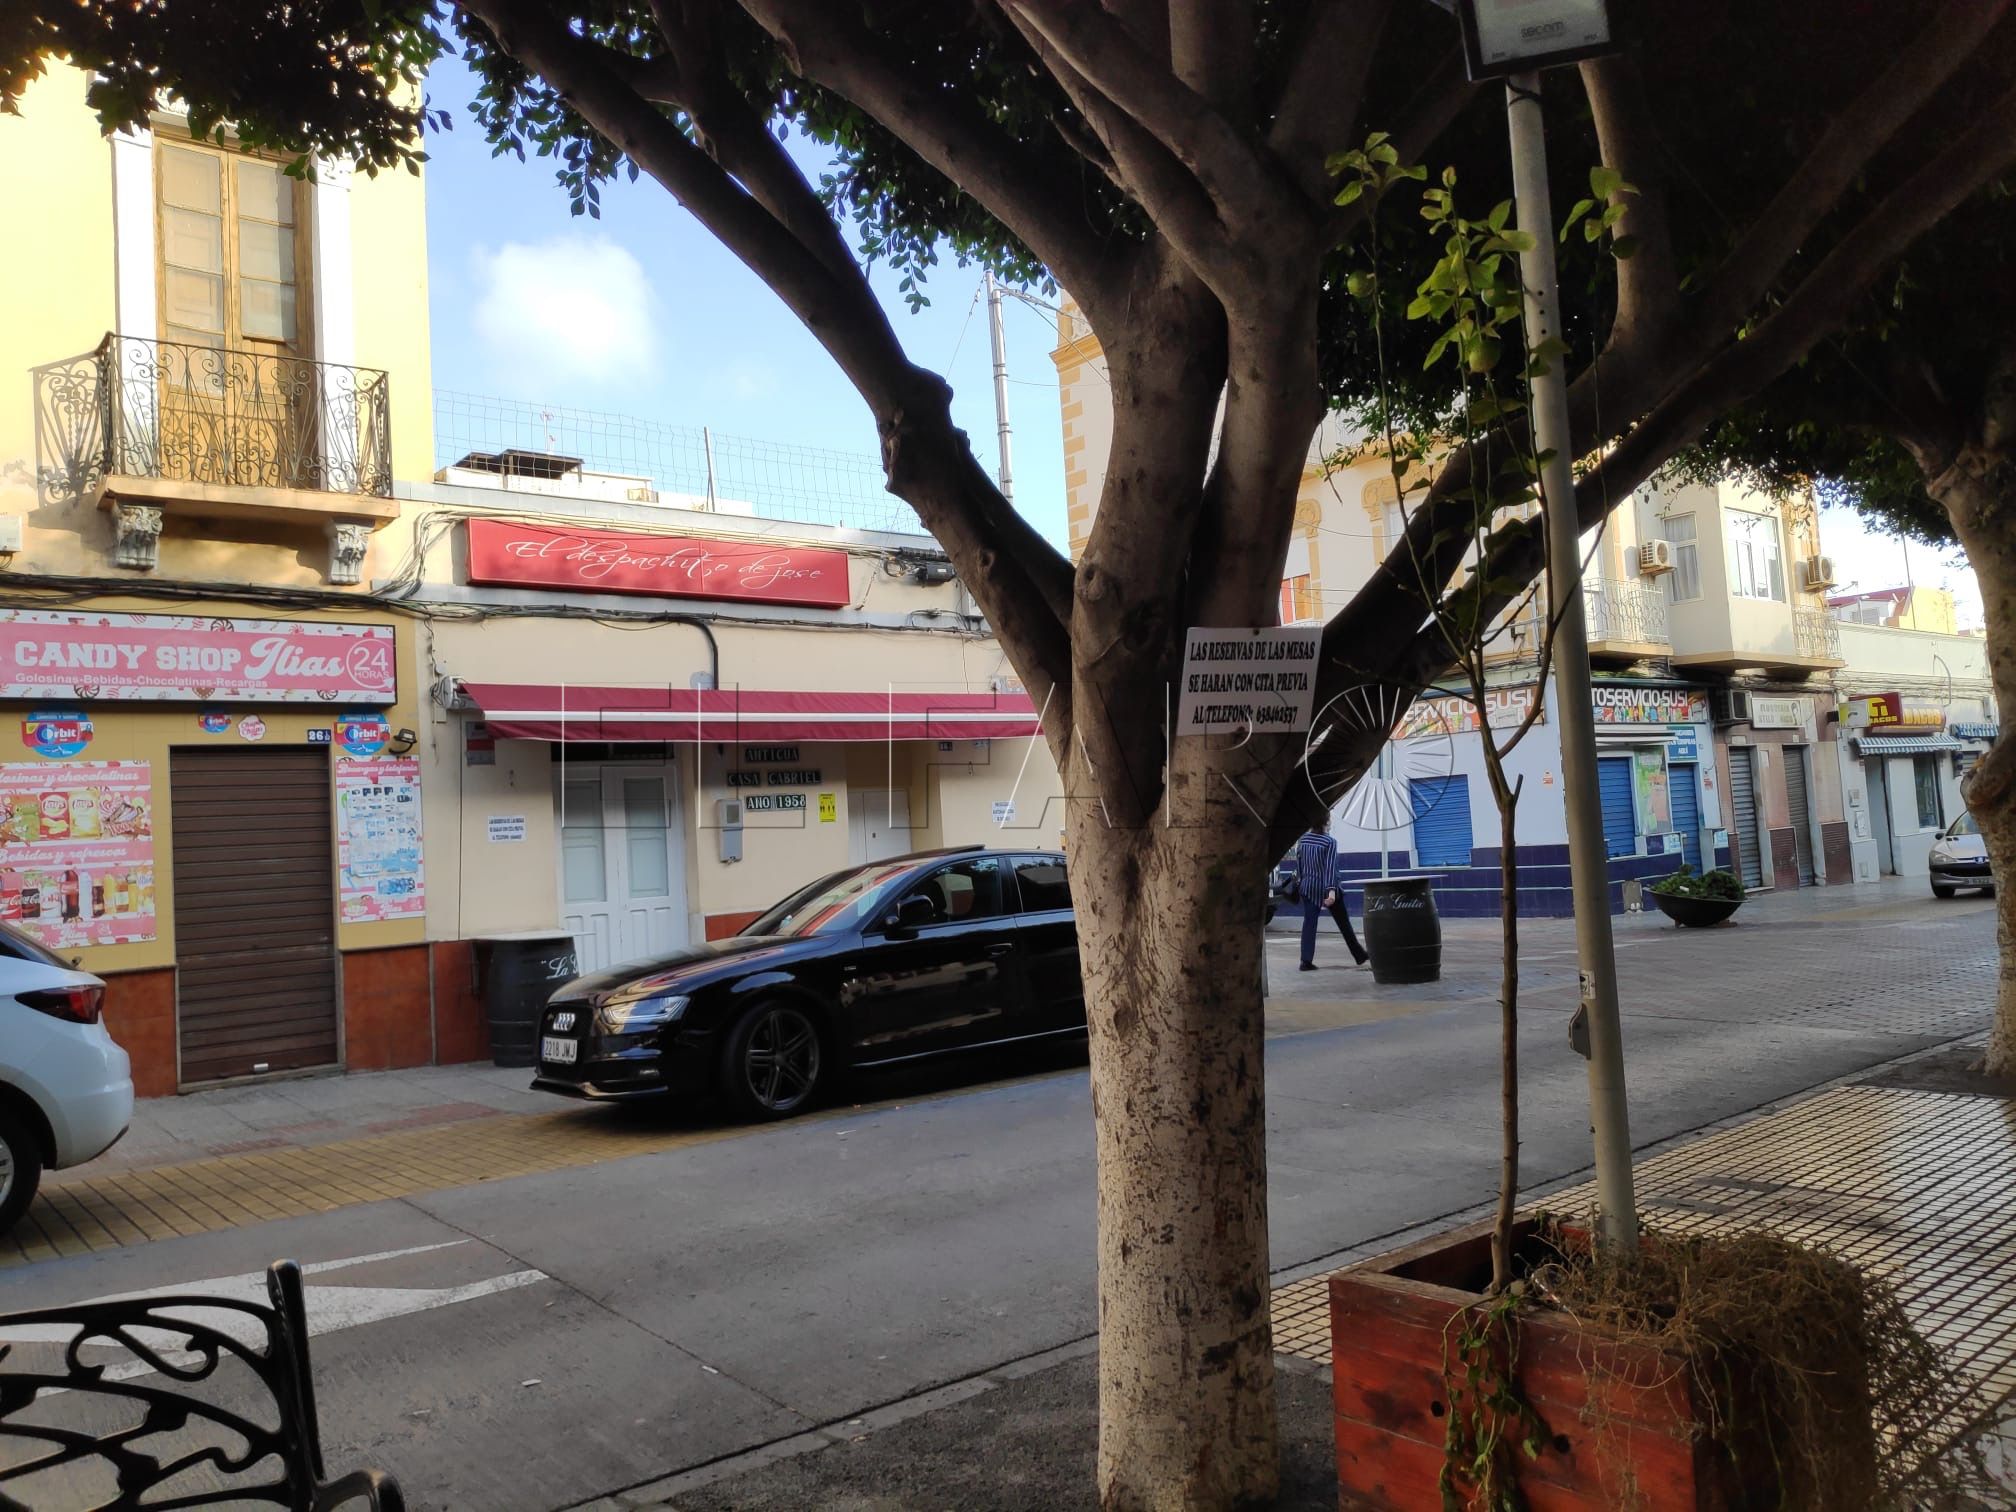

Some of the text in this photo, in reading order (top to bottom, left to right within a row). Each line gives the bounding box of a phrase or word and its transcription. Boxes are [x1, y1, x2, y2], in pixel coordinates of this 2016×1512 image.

[1521, 21, 1564, 39] secom
[506, 536, 588, 558] El
[15, 637, 345, 680] CANDY SHOP Ilias
[353, 646, 389, 672] 24
[1190, 641, 1316, 661] LAS RESERVAS DE LAS MESAS
[354, 669, 390, 680] HORAS
[1188, 672, 1308, 693] SE HARAN CON CITA PREVIA
[1485, 689, 1533, 713] SUSI
[1661, 689, 1688, 707] SUSI
[1192, 705, 1205, 724] AL
[41, 727, 78, 739] Orbit
[308, 730, 324, 741] 26
[349, 728, 378, 739] Orbit
[728, 773, 759, 786] CASA
[546, 955, 570, 980] La
